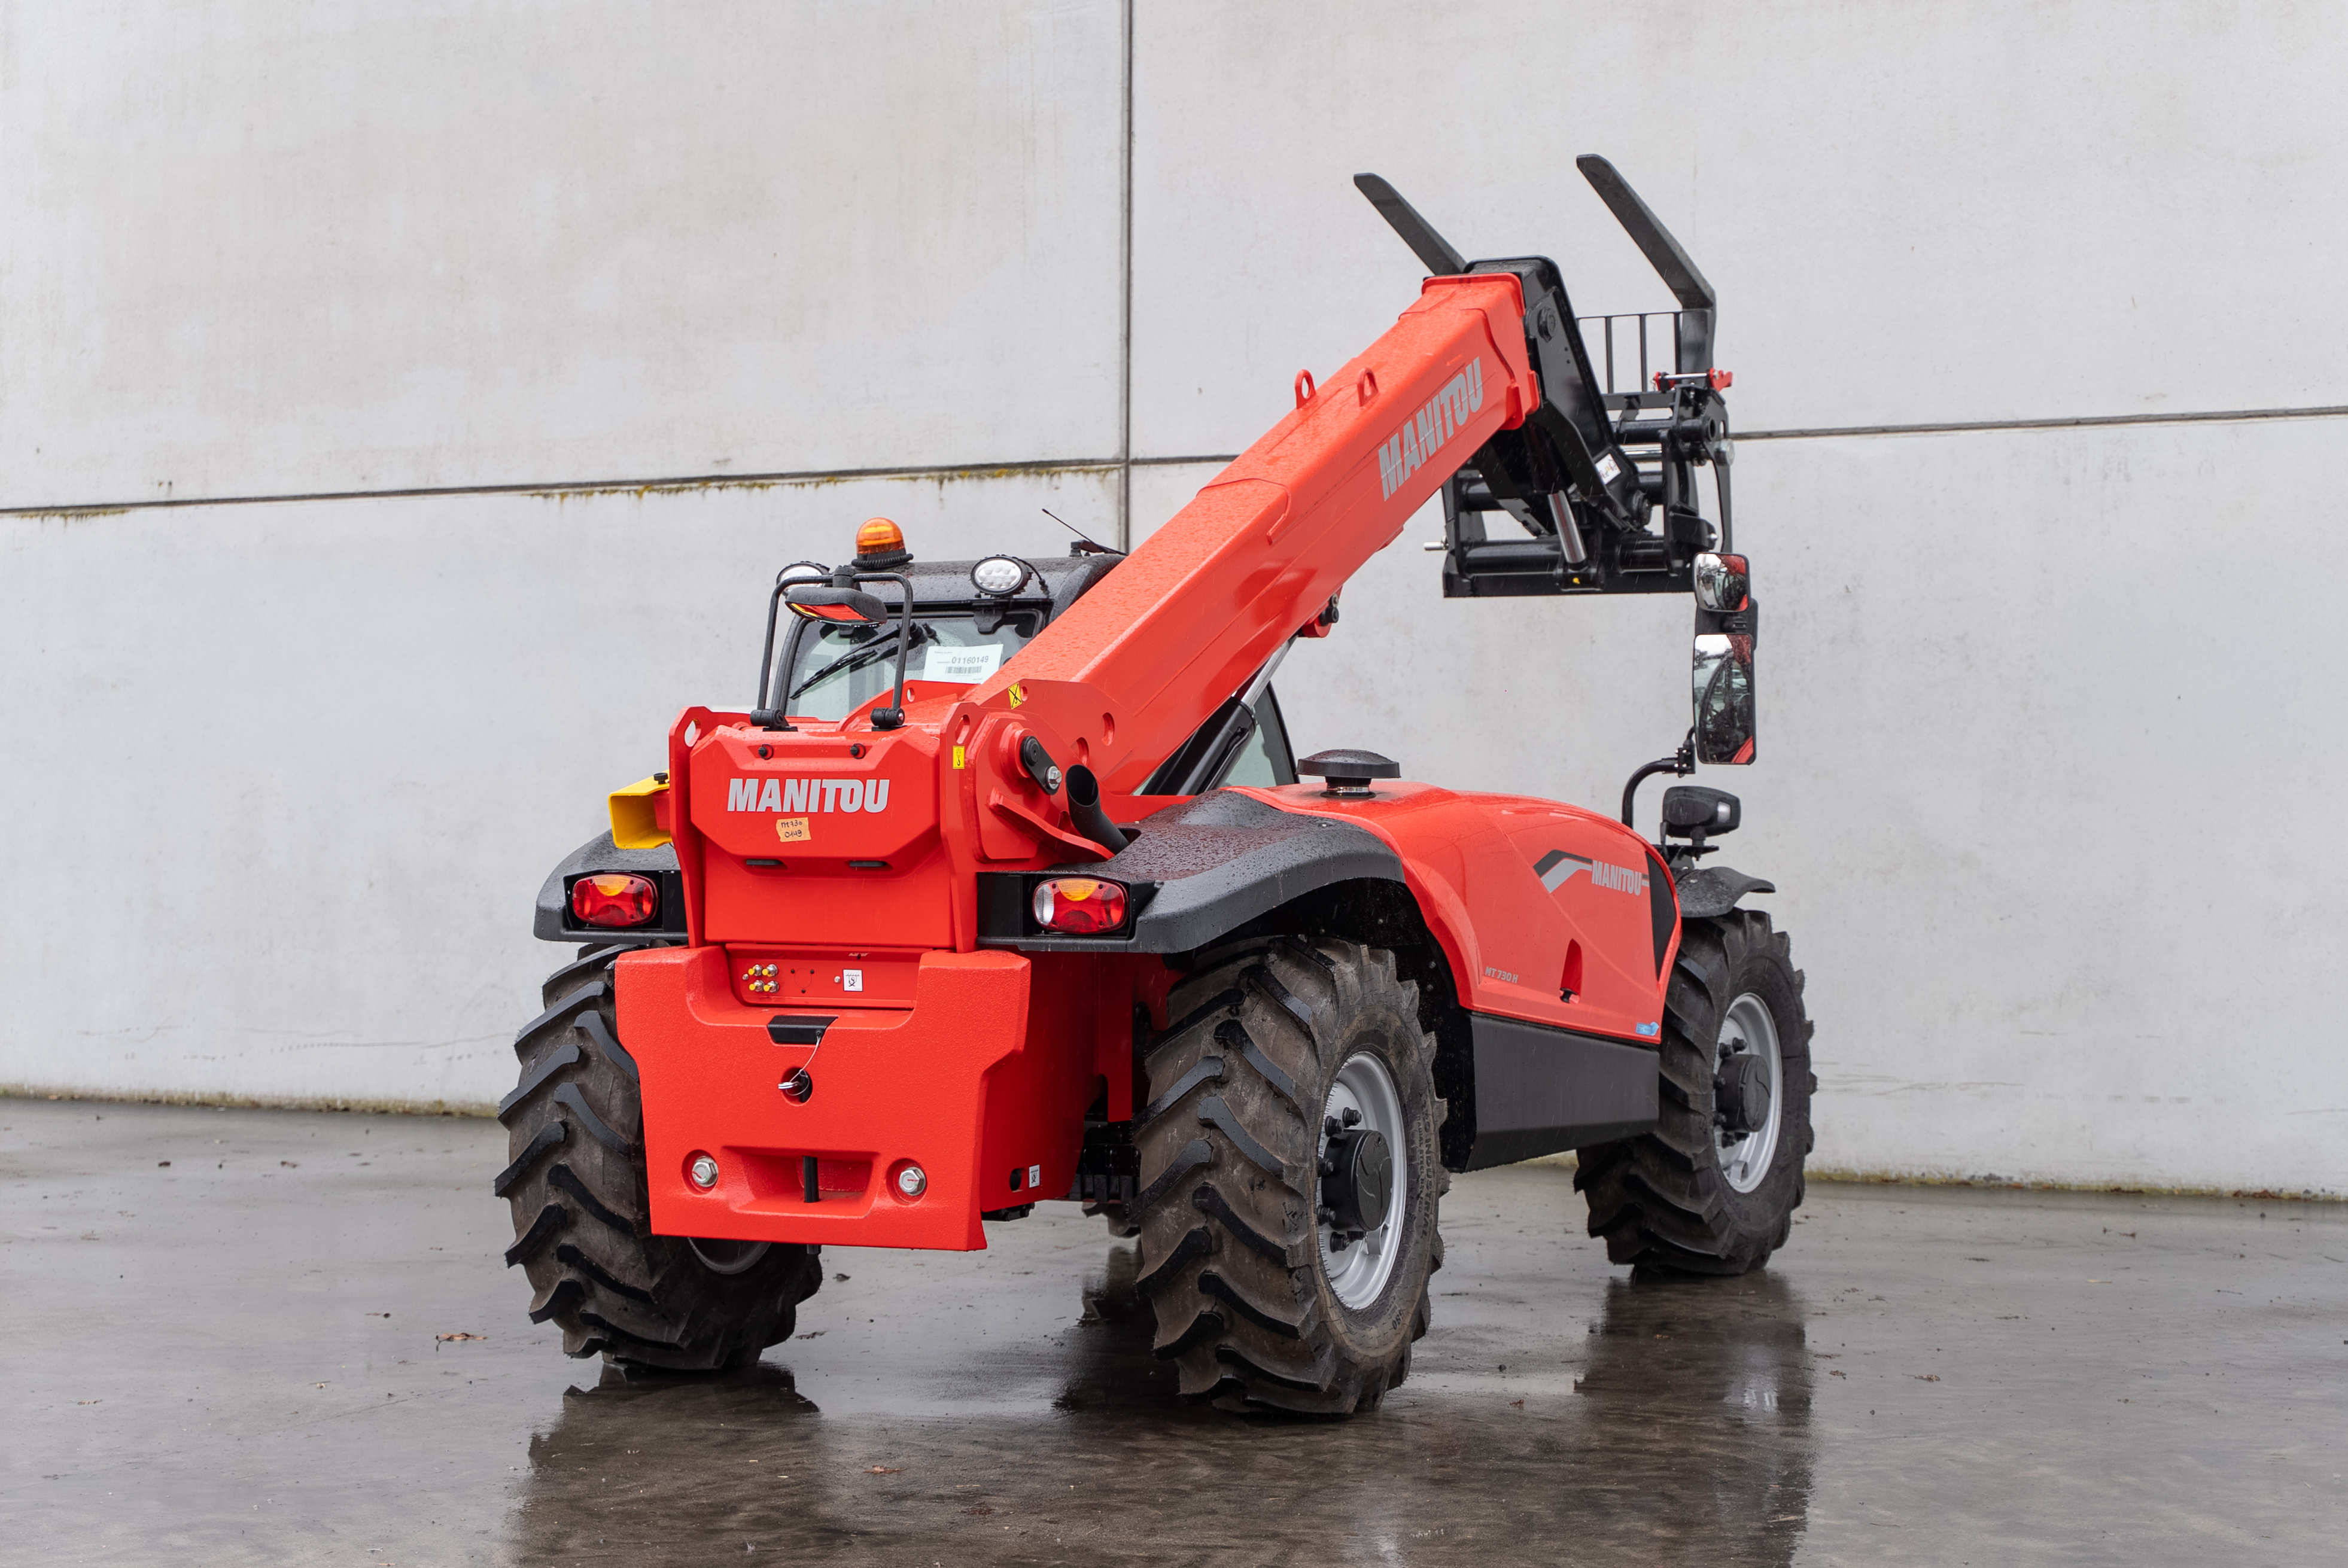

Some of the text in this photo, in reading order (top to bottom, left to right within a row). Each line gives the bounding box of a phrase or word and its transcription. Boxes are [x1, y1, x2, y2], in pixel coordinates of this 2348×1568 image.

[1378, 356, 1483, 503] MANITOU
[951, 655, 989, 665] 01160149
[727, 778, 890, 813] MANITOU
[784, 829, 802, 838] 0149
[1592, 860, 1642, 896] MANITOU
[1485, 966, 1519, 984] MT 730 H
[1421, 1138, 1432, 1238] INDUSTRIAL
